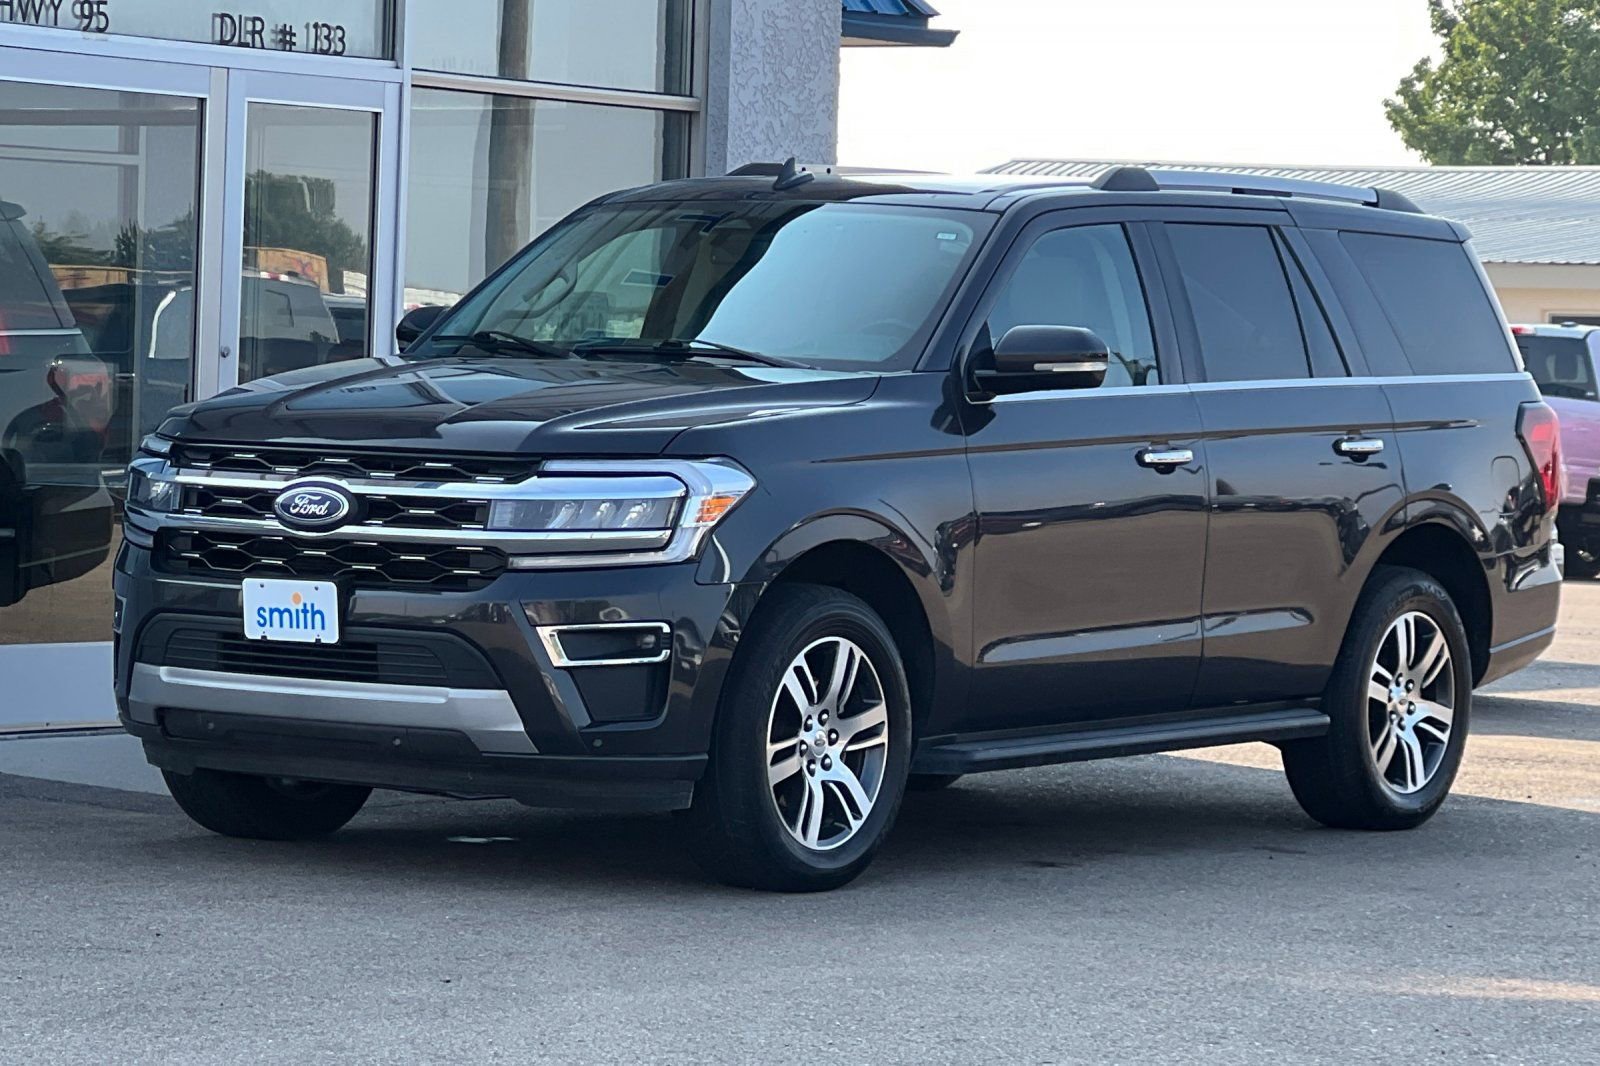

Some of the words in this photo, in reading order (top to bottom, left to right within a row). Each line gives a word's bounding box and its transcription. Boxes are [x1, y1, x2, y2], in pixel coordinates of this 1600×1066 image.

[80, 0, 109, 33] 95
[220, 12, 265, 48] DLR
[279, 23, 297, 51] #
[312, 21, 346, 56] 133
[289, 493, 331, 516] Ford
[256, 592, 326, 630] smith
